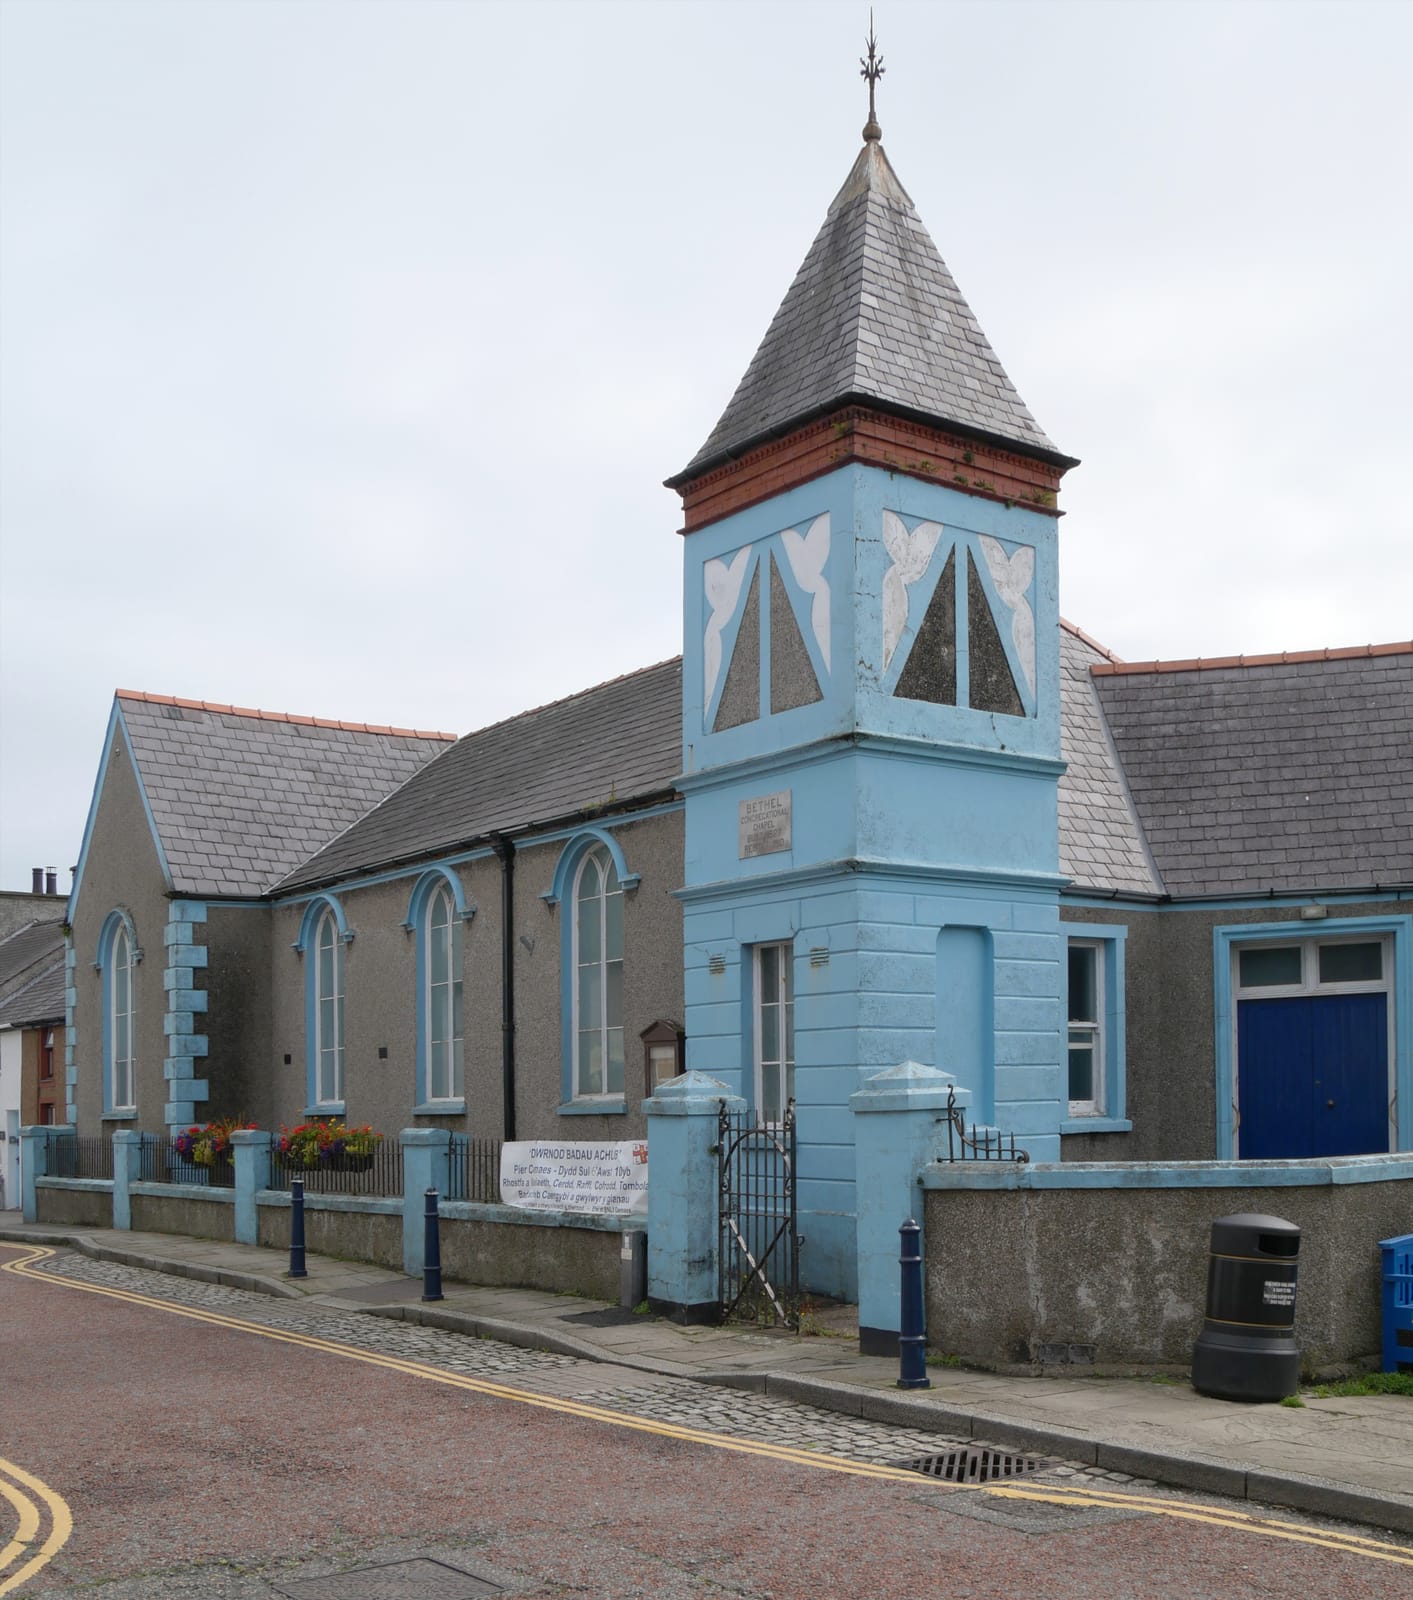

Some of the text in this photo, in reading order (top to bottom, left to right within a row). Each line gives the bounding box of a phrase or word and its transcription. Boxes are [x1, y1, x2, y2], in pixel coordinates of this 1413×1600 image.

[746, 797, 782, 814] BETHEL
[753, 820, 775, 832] CHAPEL
[566, 1149, 593, 1161] BADAU
[513, 1164, 527, 1175] Pier
[557, 1165, 577, 1178] Dydd
[578, 1166, 590, 1177] Sul
[615, 1166, 631, 1179] 10yb
[619, 1180, 649, 1191] Tombola
